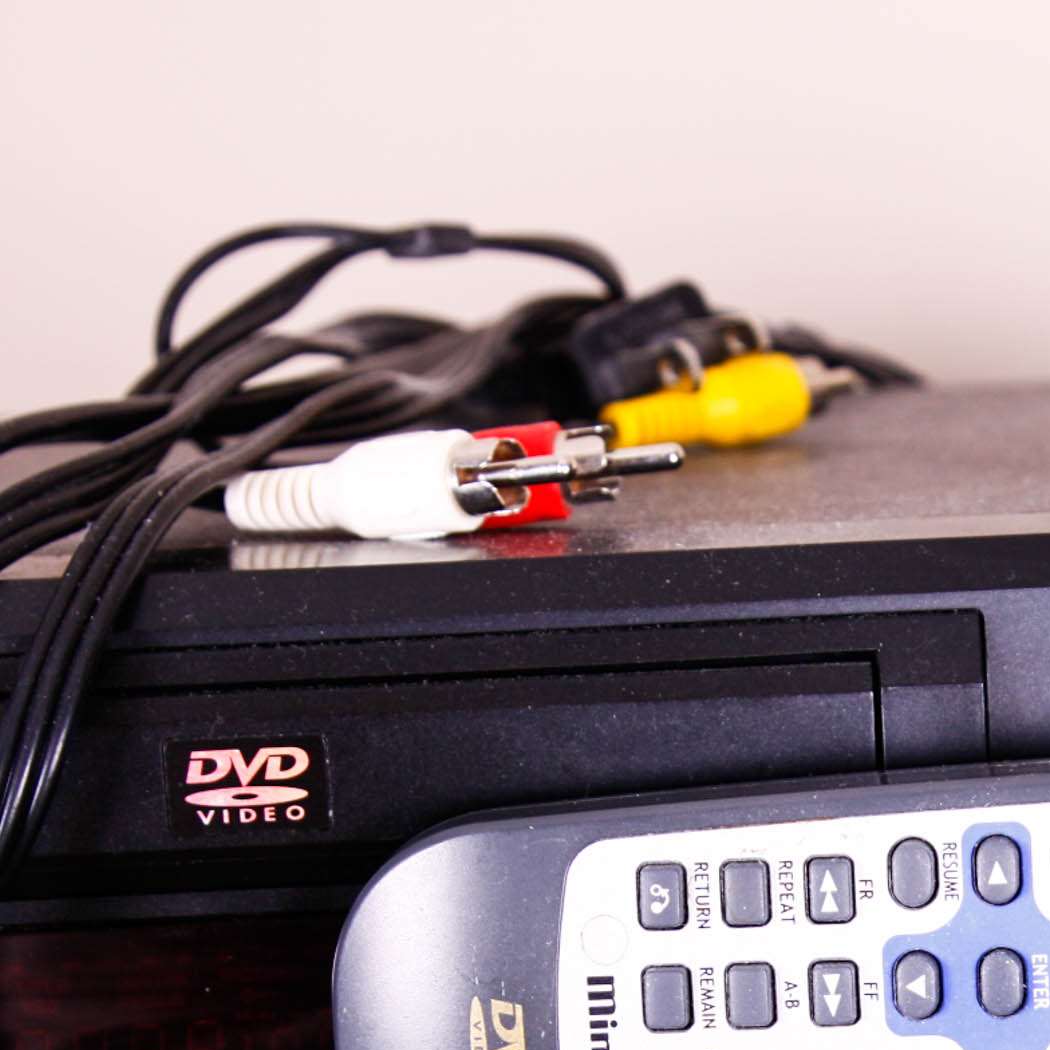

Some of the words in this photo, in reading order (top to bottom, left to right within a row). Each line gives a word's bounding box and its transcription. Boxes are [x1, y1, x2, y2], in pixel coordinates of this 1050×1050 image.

[186, 747, 310, 786] DVD
[196, 805, 305, 826] VIDEO
[694, 862, 710, 928] RETURN
[779, 861, 795, 923] REPEAT
[859, 880, 873, 899] FR
[943, 842, 959, 900] RESUME
[700, 968, 716, 1028] REMAIN
[785, 981, 799, 1008] A-B
[863, 982, 878, 1001] FF
[1032, 953, 1050, 1010] ENTER
